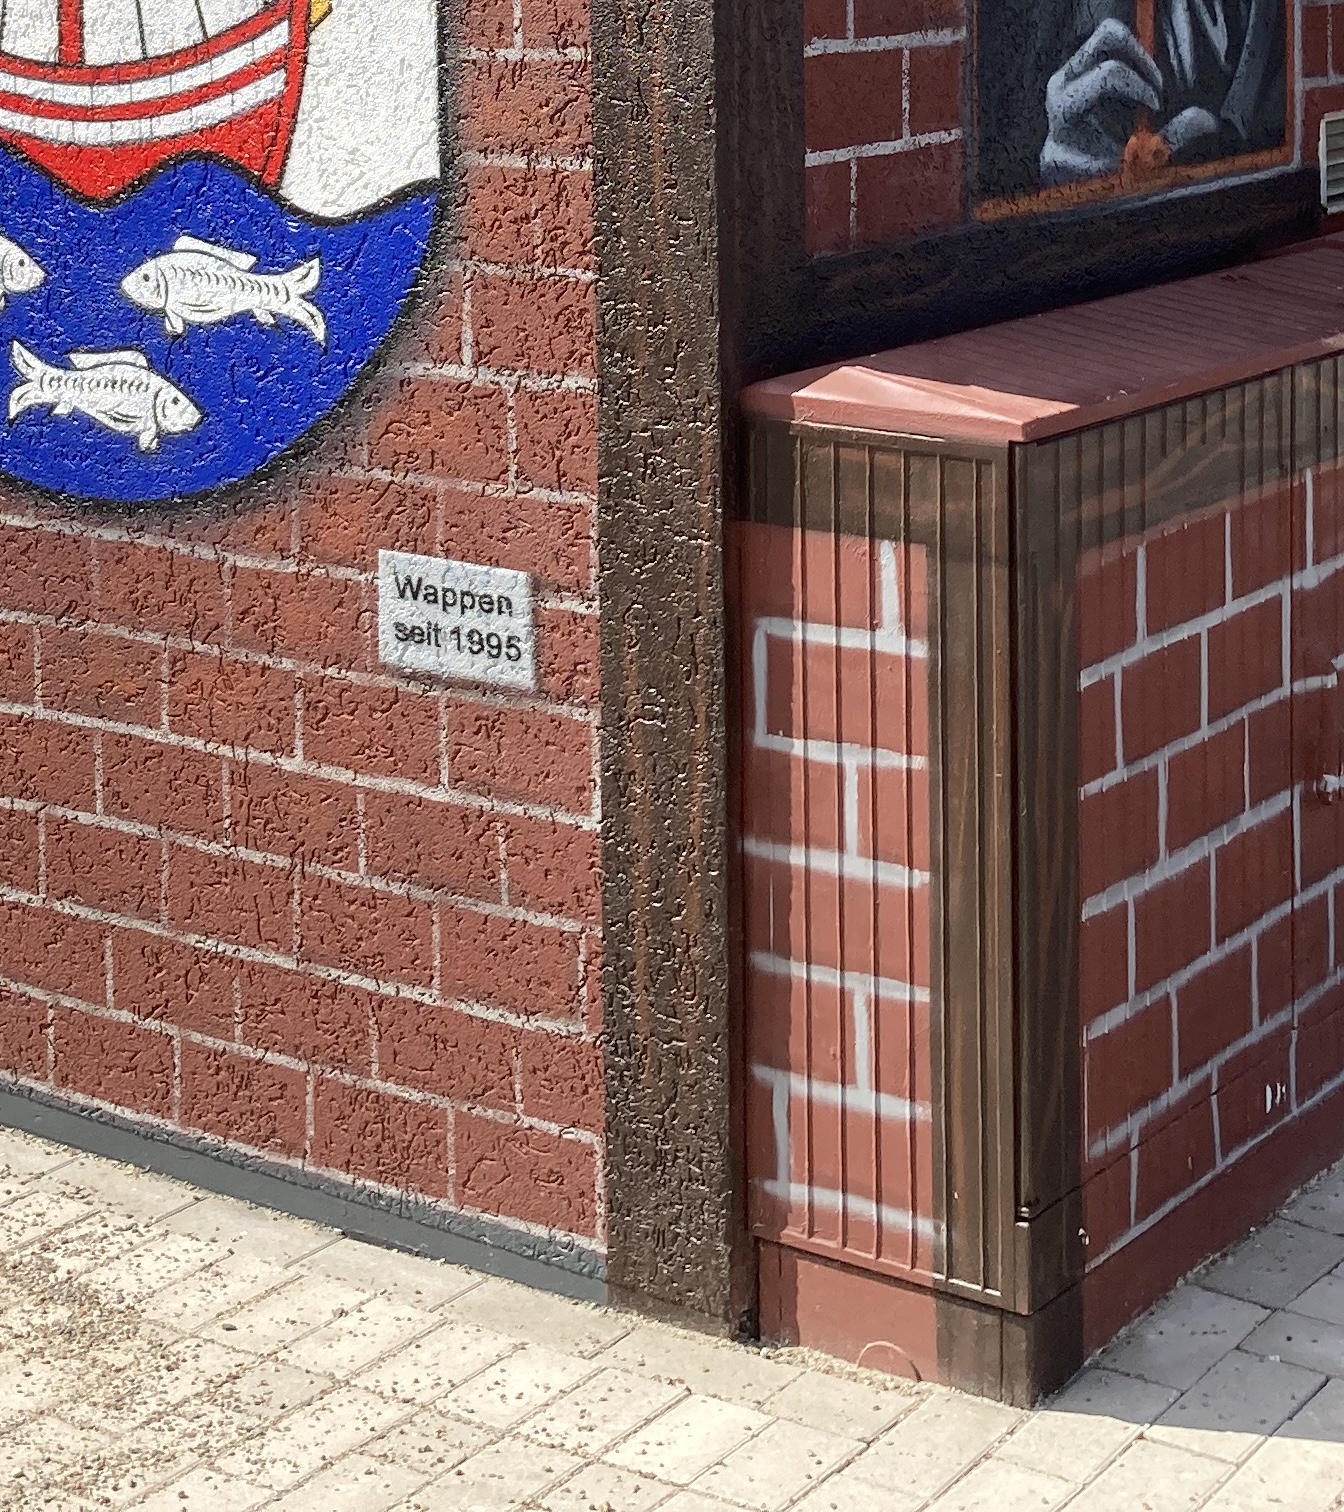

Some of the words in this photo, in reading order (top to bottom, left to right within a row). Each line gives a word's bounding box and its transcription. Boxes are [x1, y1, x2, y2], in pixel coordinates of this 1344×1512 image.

[394, 573, 513, 617] Wappen
[394, 620, 441, 648] seit
[450, 625, 522, 662] 1995
